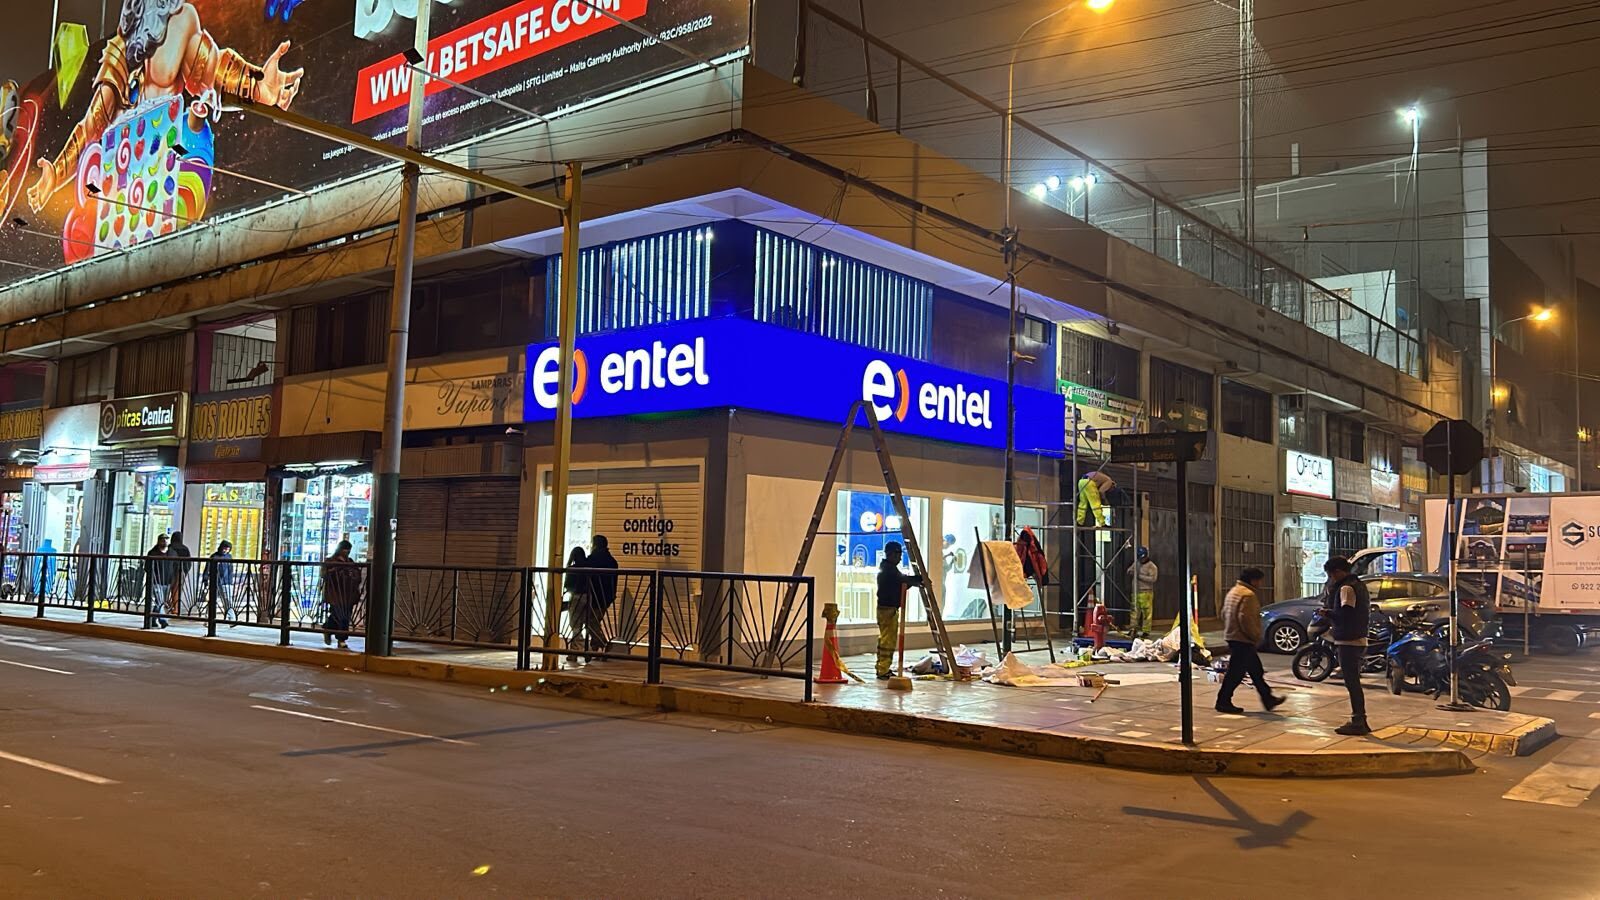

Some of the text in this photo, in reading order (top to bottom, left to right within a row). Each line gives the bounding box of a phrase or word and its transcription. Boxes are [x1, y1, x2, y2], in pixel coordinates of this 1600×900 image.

[459, 99, 480, 114] pueden
[525, 75, 541, 89] SFTG
[541, 67, 564, 84] Limited
[569, 61, 586, 74] Malta
[586, 52, 612, 68] Gaming
[612, 41, 642, 59] Authority
[600, 336, 709, 393] entel
[471, 377, 513, 390] LAMPARAS
[142, 403, 174, 426] Central
[218, 394, 273, 441] ROBLES
[918, 382, 992, 429] entel
[623, 515, 674, 537] contigo
[622, 540, 680, 557] en todas
